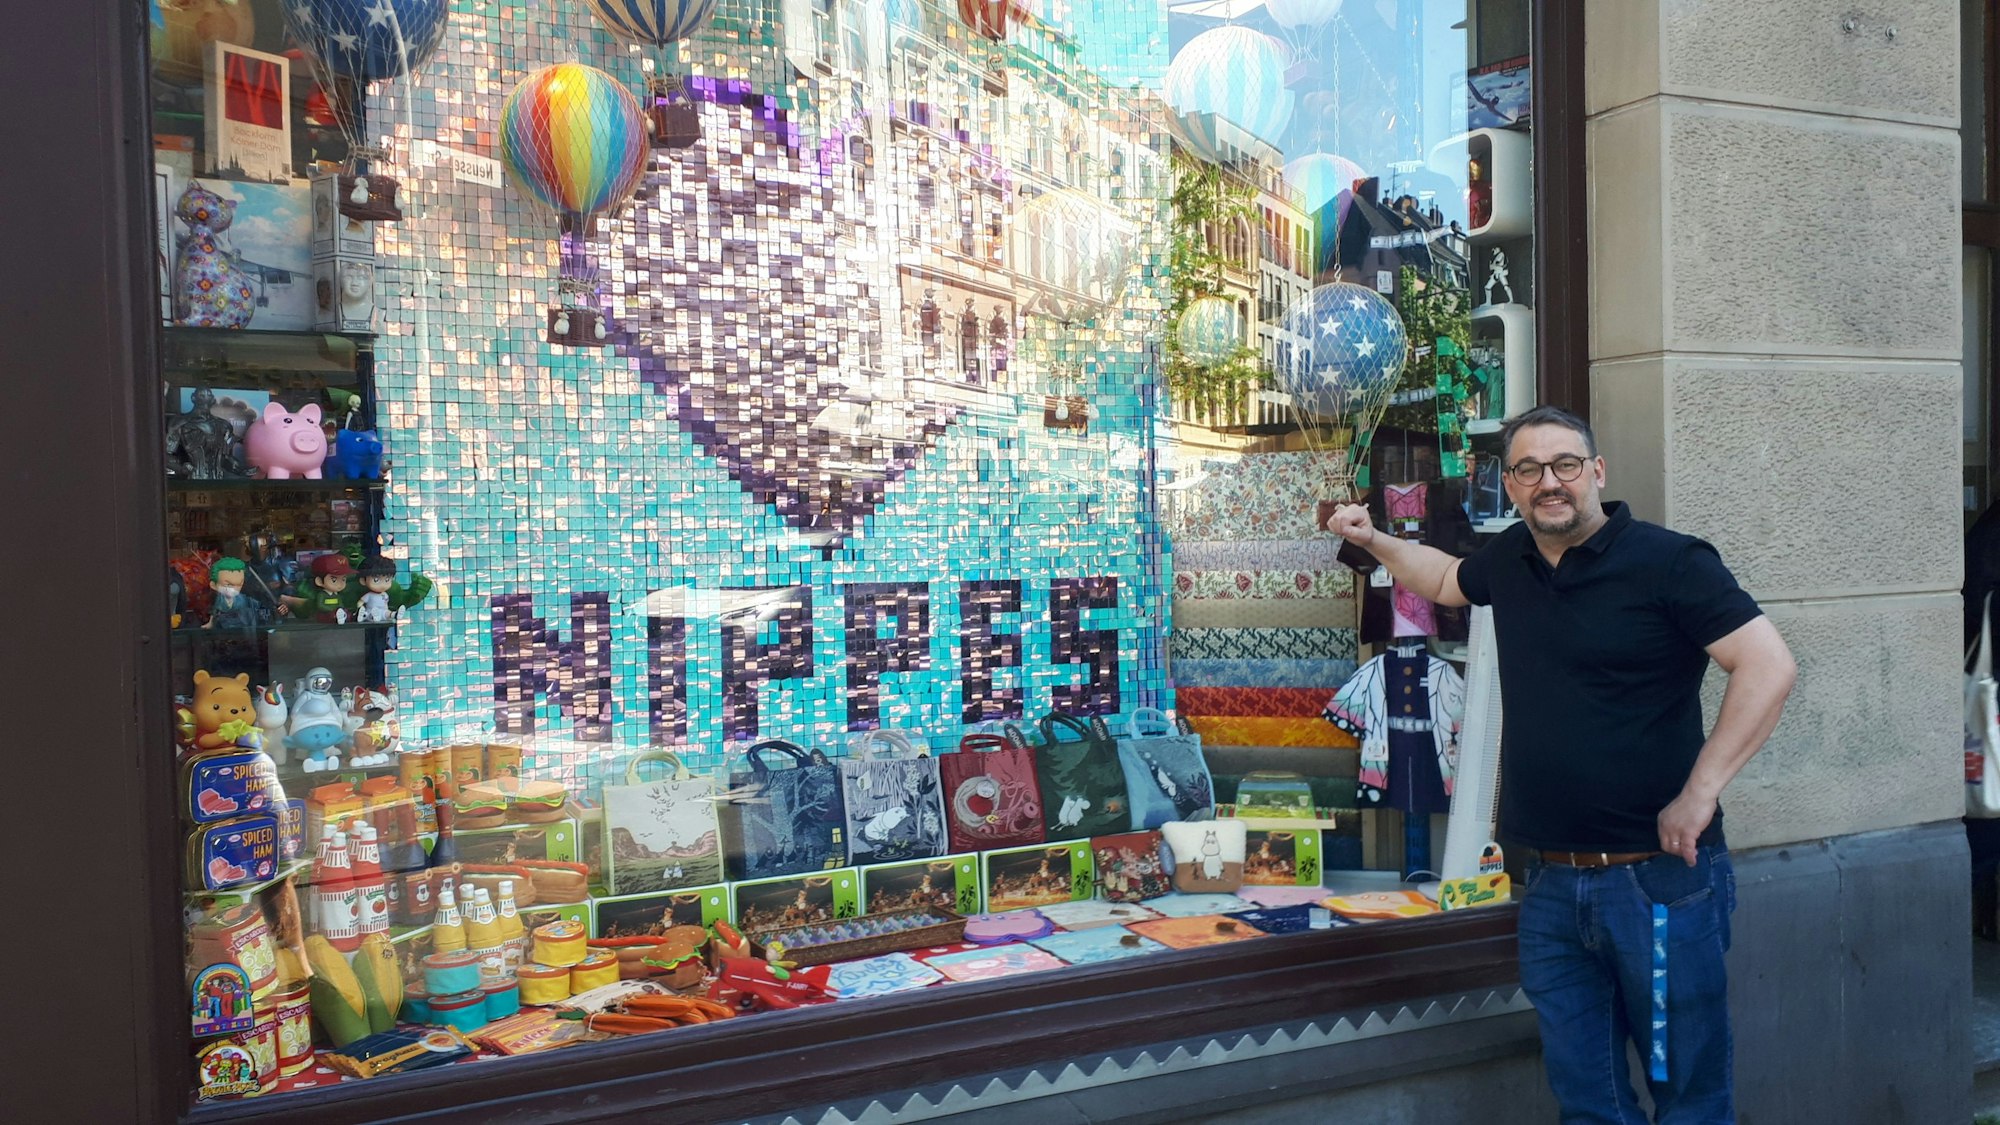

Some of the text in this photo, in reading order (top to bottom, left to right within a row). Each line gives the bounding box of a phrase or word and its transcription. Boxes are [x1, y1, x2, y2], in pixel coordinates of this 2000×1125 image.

[491, 577, 1120, 743] NIPPES
[233, 762, 267, 780] SPICED
[246, 779, 268, 793] HAM
[279, 808, 300, 824] ICED
[242, 828, 273, 847] SPICED
[280, 823, 300, 838] HAM
[253, 845, 273, 859] HAM
[1480, 863, 1502, 872] NIPPES
